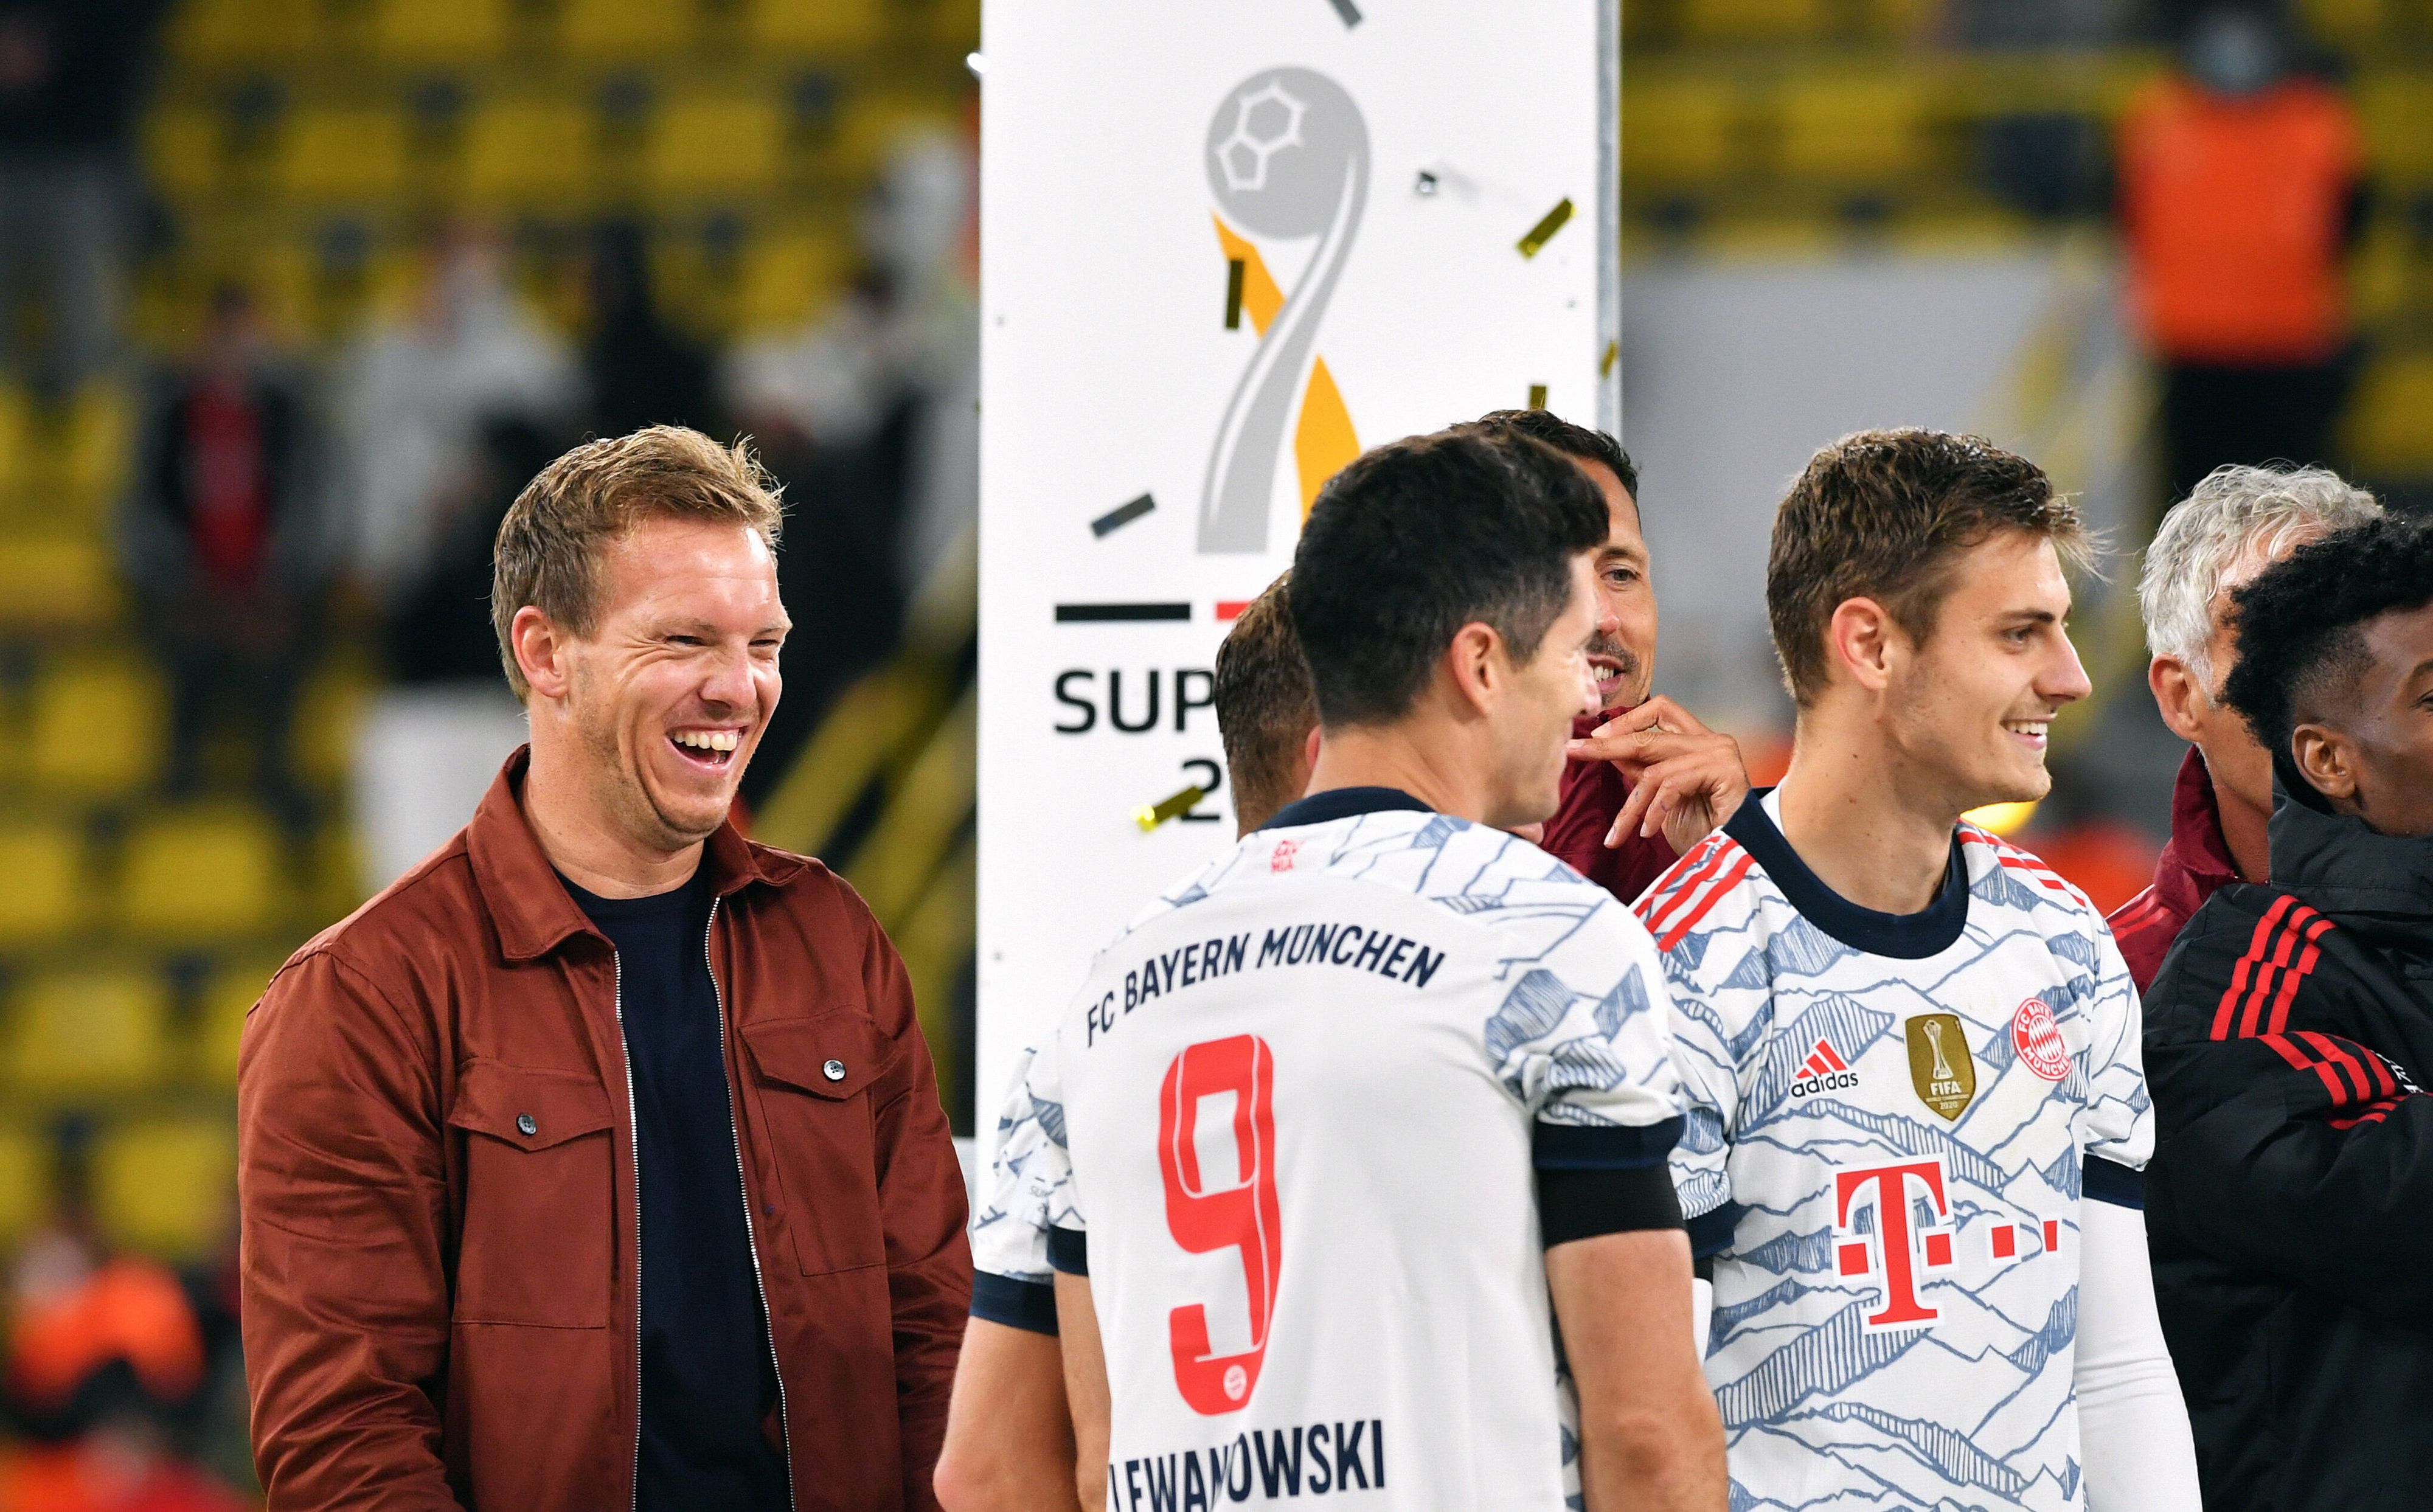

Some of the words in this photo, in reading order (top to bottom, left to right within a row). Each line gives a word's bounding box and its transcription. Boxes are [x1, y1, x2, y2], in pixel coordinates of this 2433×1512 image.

[1053, 670, 1215, 733] SUP
[1182, 759, 1221, 822] 2
[1088, 991, 1114, 1048] FC
[1124, 932, 1251, 1015] BAYERN
[1256, 923, 1445, 988] MÜNCHEN
[2017, 1013, 2030, 1033] FC
[1791, 1072, 1859, 1098] adidas
[1930, 1080, 1962, 1096] FIFA
[1158, 1033, 1281, 1417] 9
[1109, 1419, 1385, 1512] LEWANOWSKI
